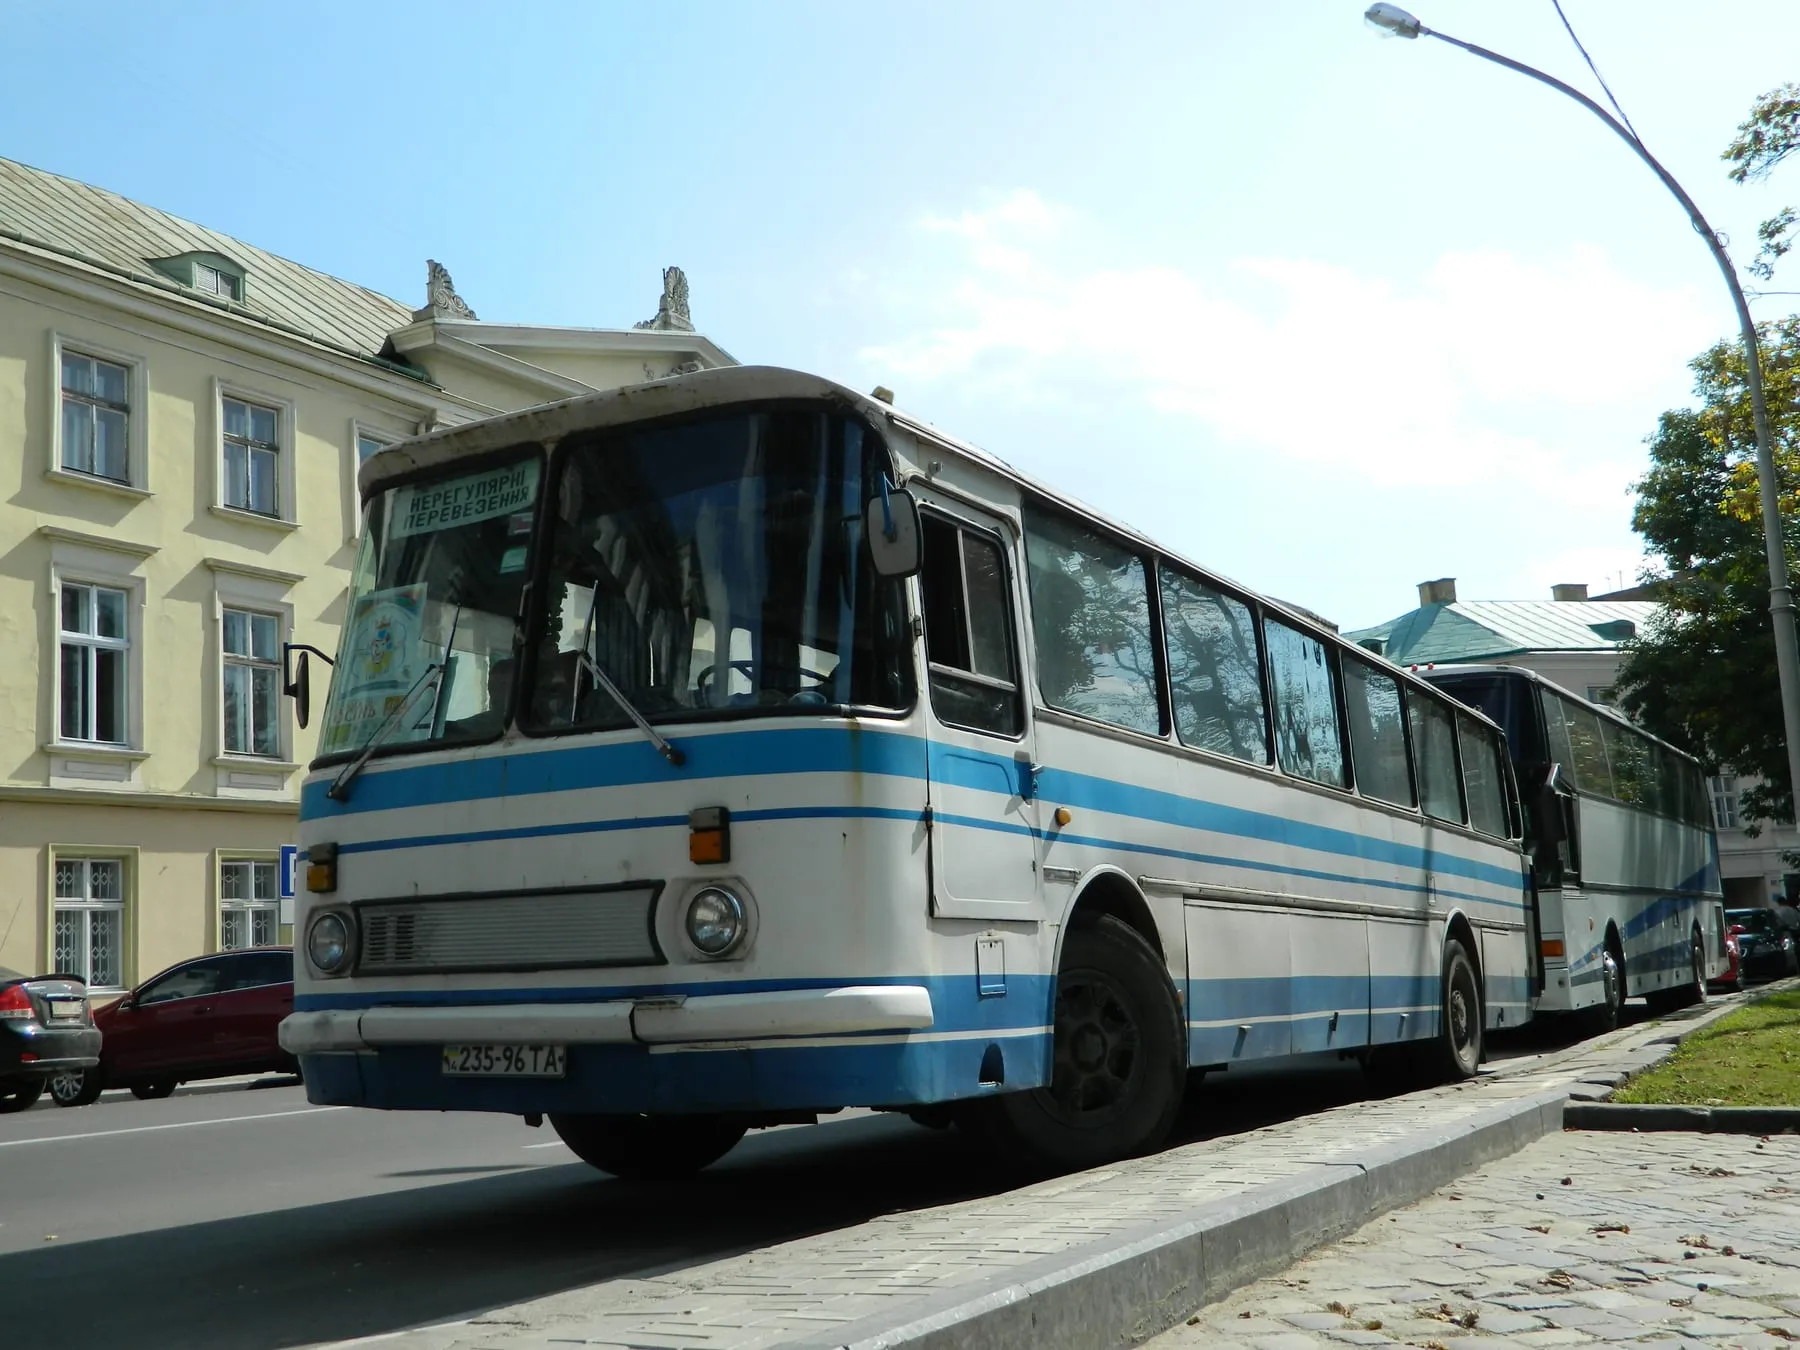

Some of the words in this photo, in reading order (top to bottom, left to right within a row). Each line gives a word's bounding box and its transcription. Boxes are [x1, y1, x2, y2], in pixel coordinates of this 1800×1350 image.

[403, 486, 529, 530] ПЕРЕВЕЗЕННЯ
[410, 466, 527, 513] НЕРЕГУЛЯРНІ
[459, 1046, 525, 1073] 235-96
